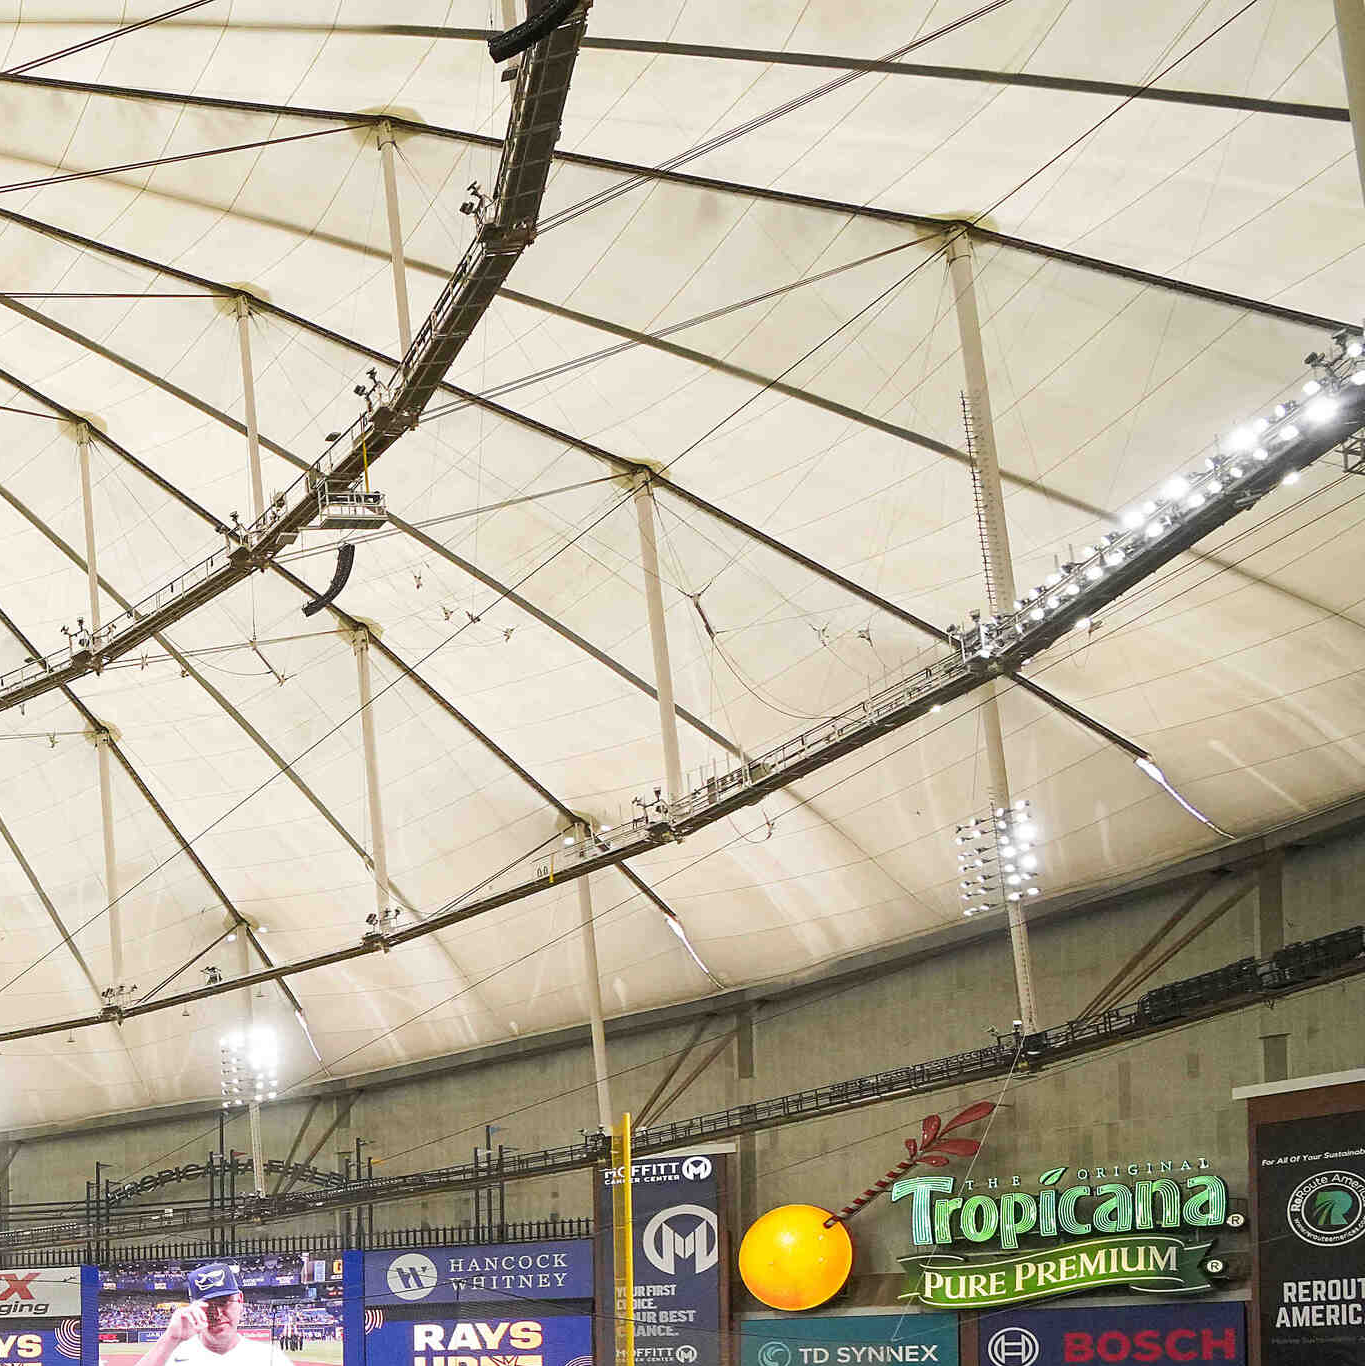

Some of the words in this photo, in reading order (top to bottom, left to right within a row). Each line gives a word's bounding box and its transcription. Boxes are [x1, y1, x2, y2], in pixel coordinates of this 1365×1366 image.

[1261, 1159, 1275, 1167] For
[1276, 1157, 1288, 1166] All
[1289, 1154, 1301, 1163] Of
[1302, 1152, 1322, 1162] Your
[644, 1175, 680, 1184] CENTER
[965, 1175, 1020, 1191] THE
[1077, 1158, 1209, 1180] ORIGINAL
[891, 1175, 1227, 1249] Tropicana
[449, 1253, 568, 1272] HANCOCK
[450, 1272, 568, 1291] WHITNEY
[923, 1270, 1007, 1300] PURE
[1015, 1246, 1178, 1292] PREMIUM
[647, 1285, 677, 1296] FIRST
[659, 1310, 696, 1323] BEST
[413, 1321, 543, 1351] RAYS
[1063, 1328, 1236, 1363] BOSCH
[798, 1347, 830, 1365] TD
[837, 1344, 938, 1364] SYNNEX
